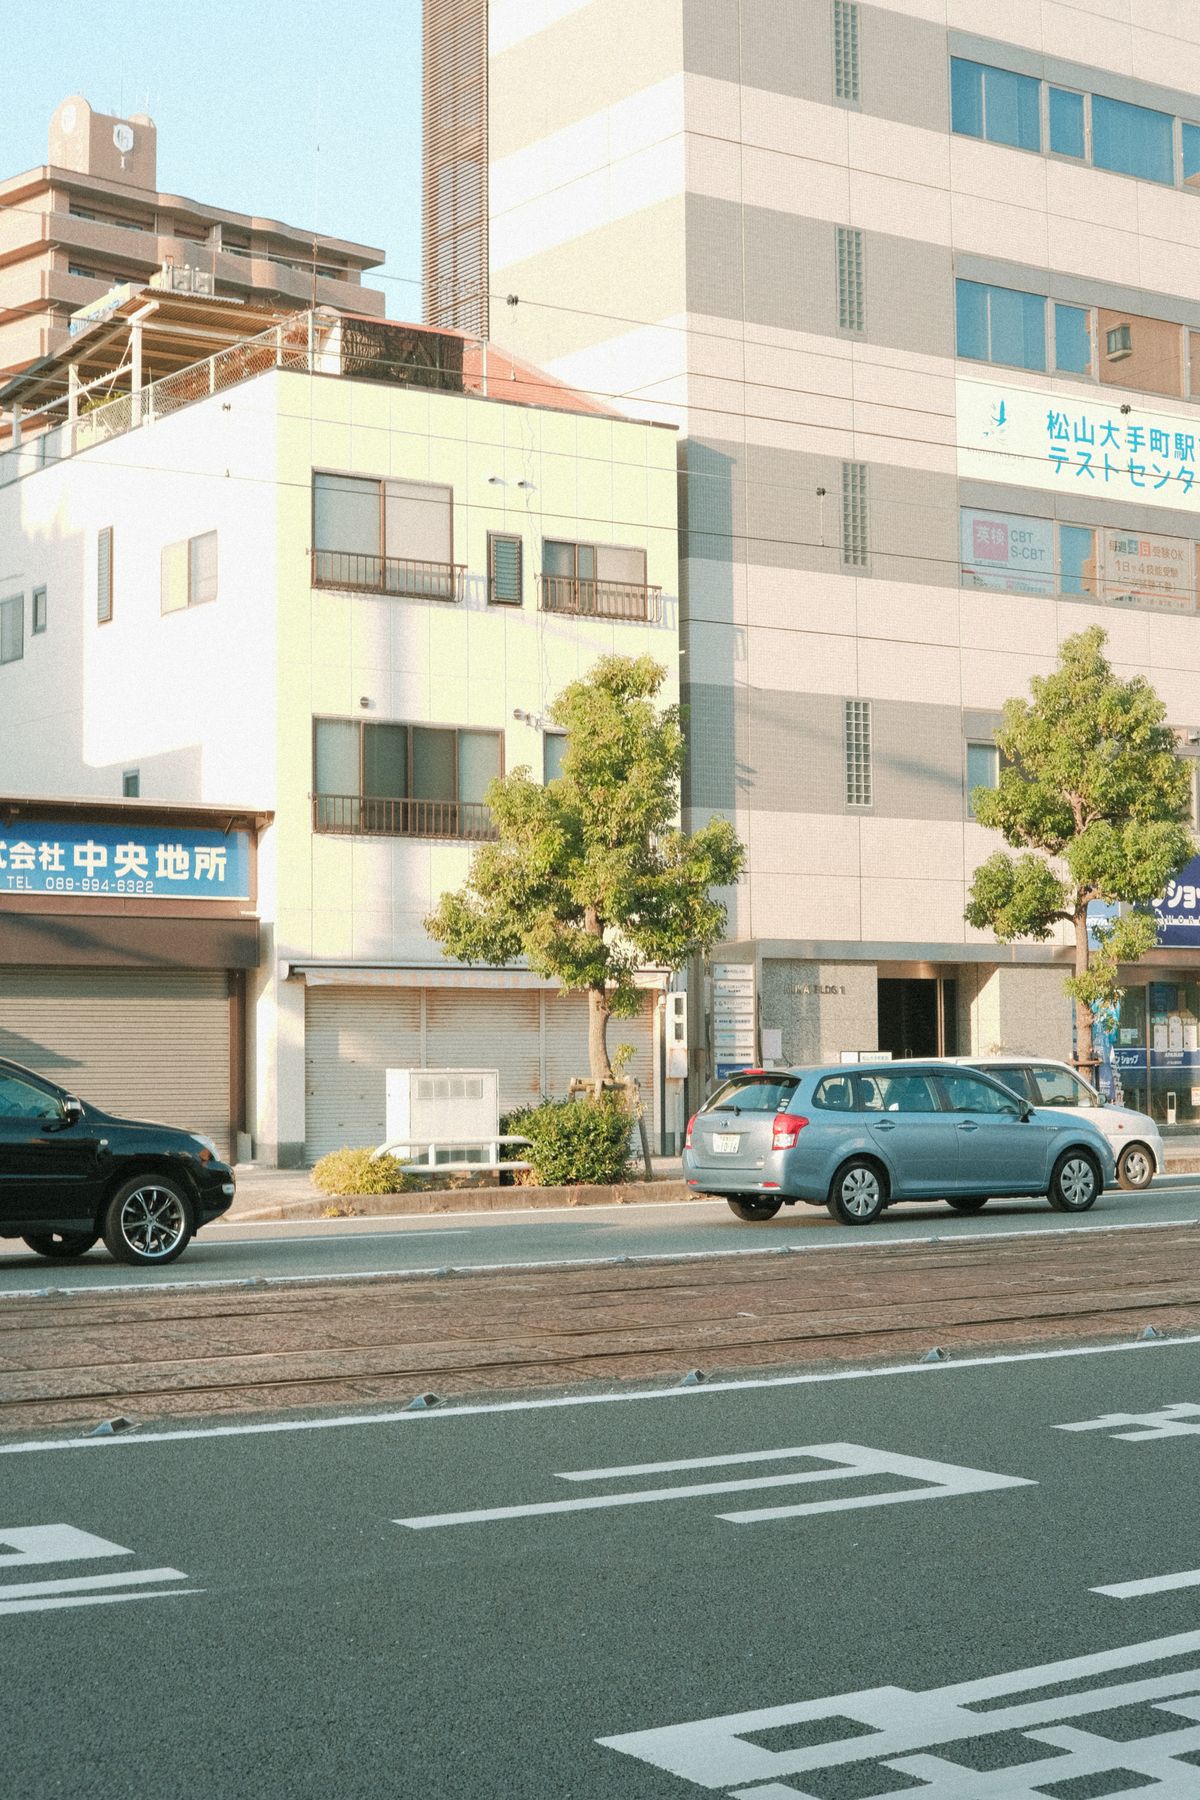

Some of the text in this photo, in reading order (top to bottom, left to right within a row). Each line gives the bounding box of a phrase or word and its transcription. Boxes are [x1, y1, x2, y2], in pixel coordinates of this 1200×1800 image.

[1046, 410, 1200, 462] 松山大手町駅
[1048, 446, 1195, 494] テストセンタ
[1010, 530, 1034, 544] CBT
[1010, 545, 1045, 561] S-CBT
[0, 840, 227, 882] 会社中央地所
[7, 875, 154, 893] TEL 089-994-6322
[1166, 914, 1200, 924] WOR
